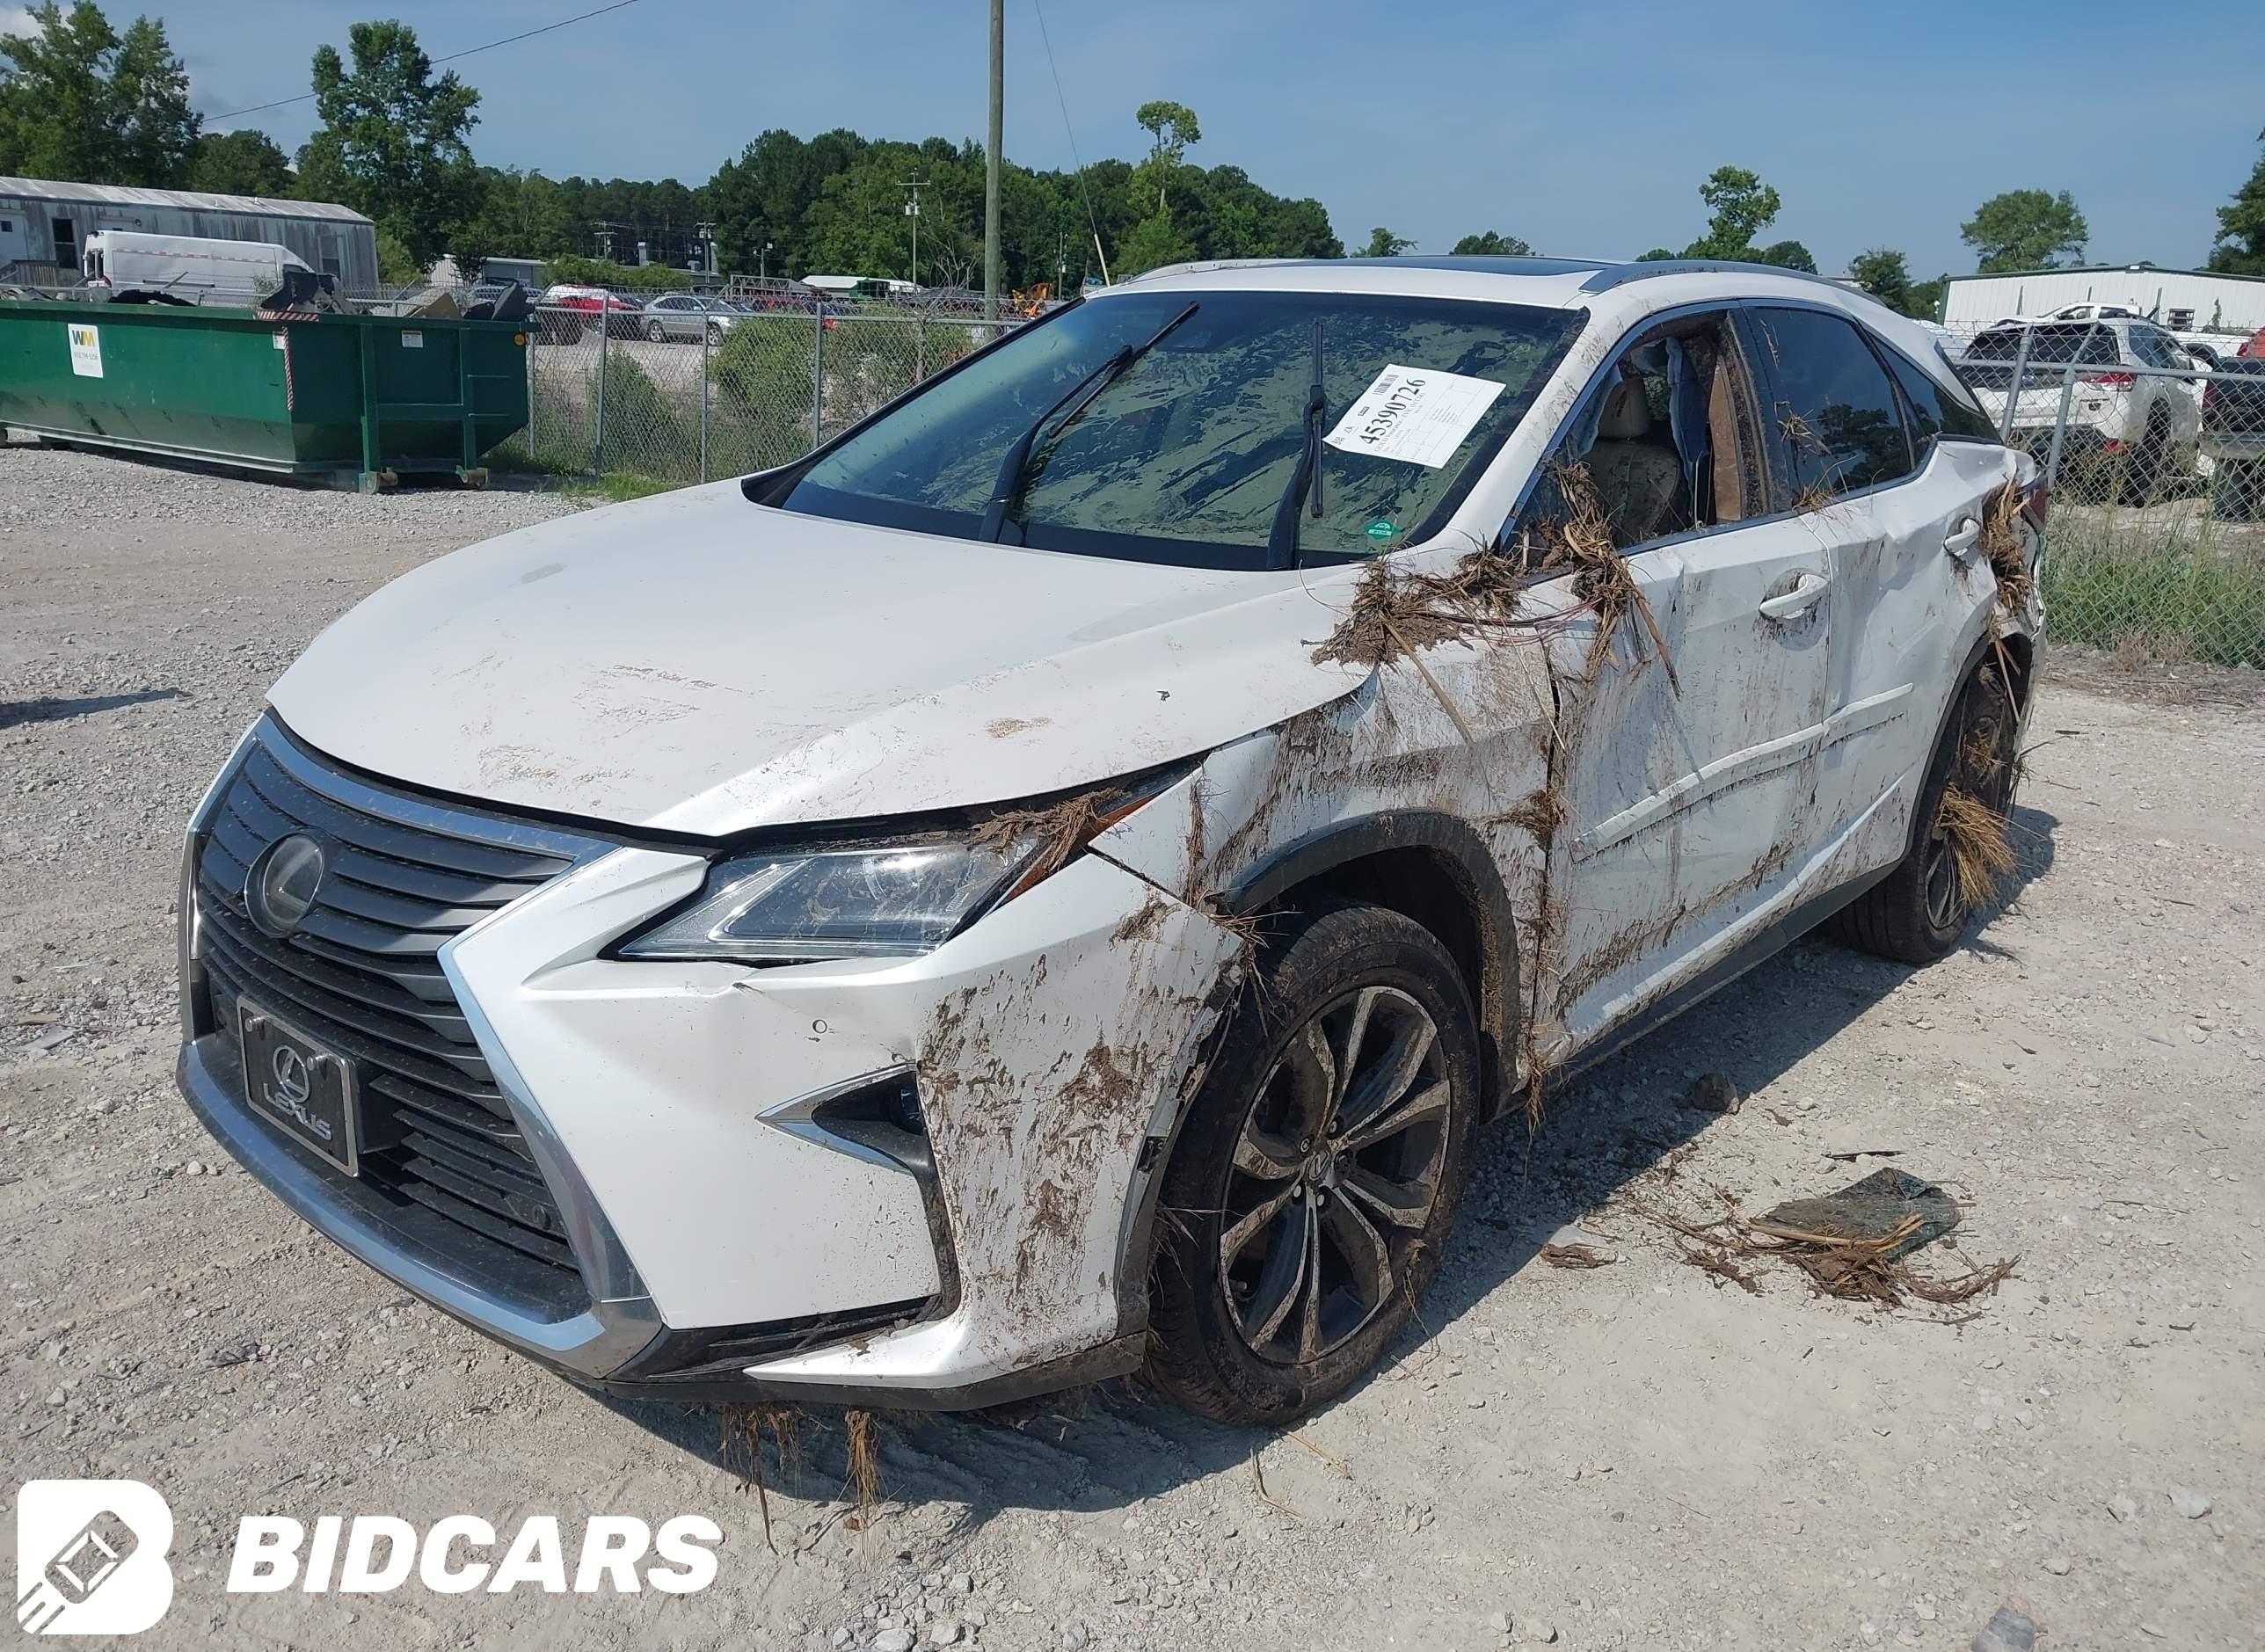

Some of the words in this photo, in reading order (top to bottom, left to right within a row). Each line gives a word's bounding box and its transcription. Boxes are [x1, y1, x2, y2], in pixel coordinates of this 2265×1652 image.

[71, 330, 95, 347] WM
[1359, 378, 1426, 444] 45390726
[263, 1082, 331, 1140] LEXUS
